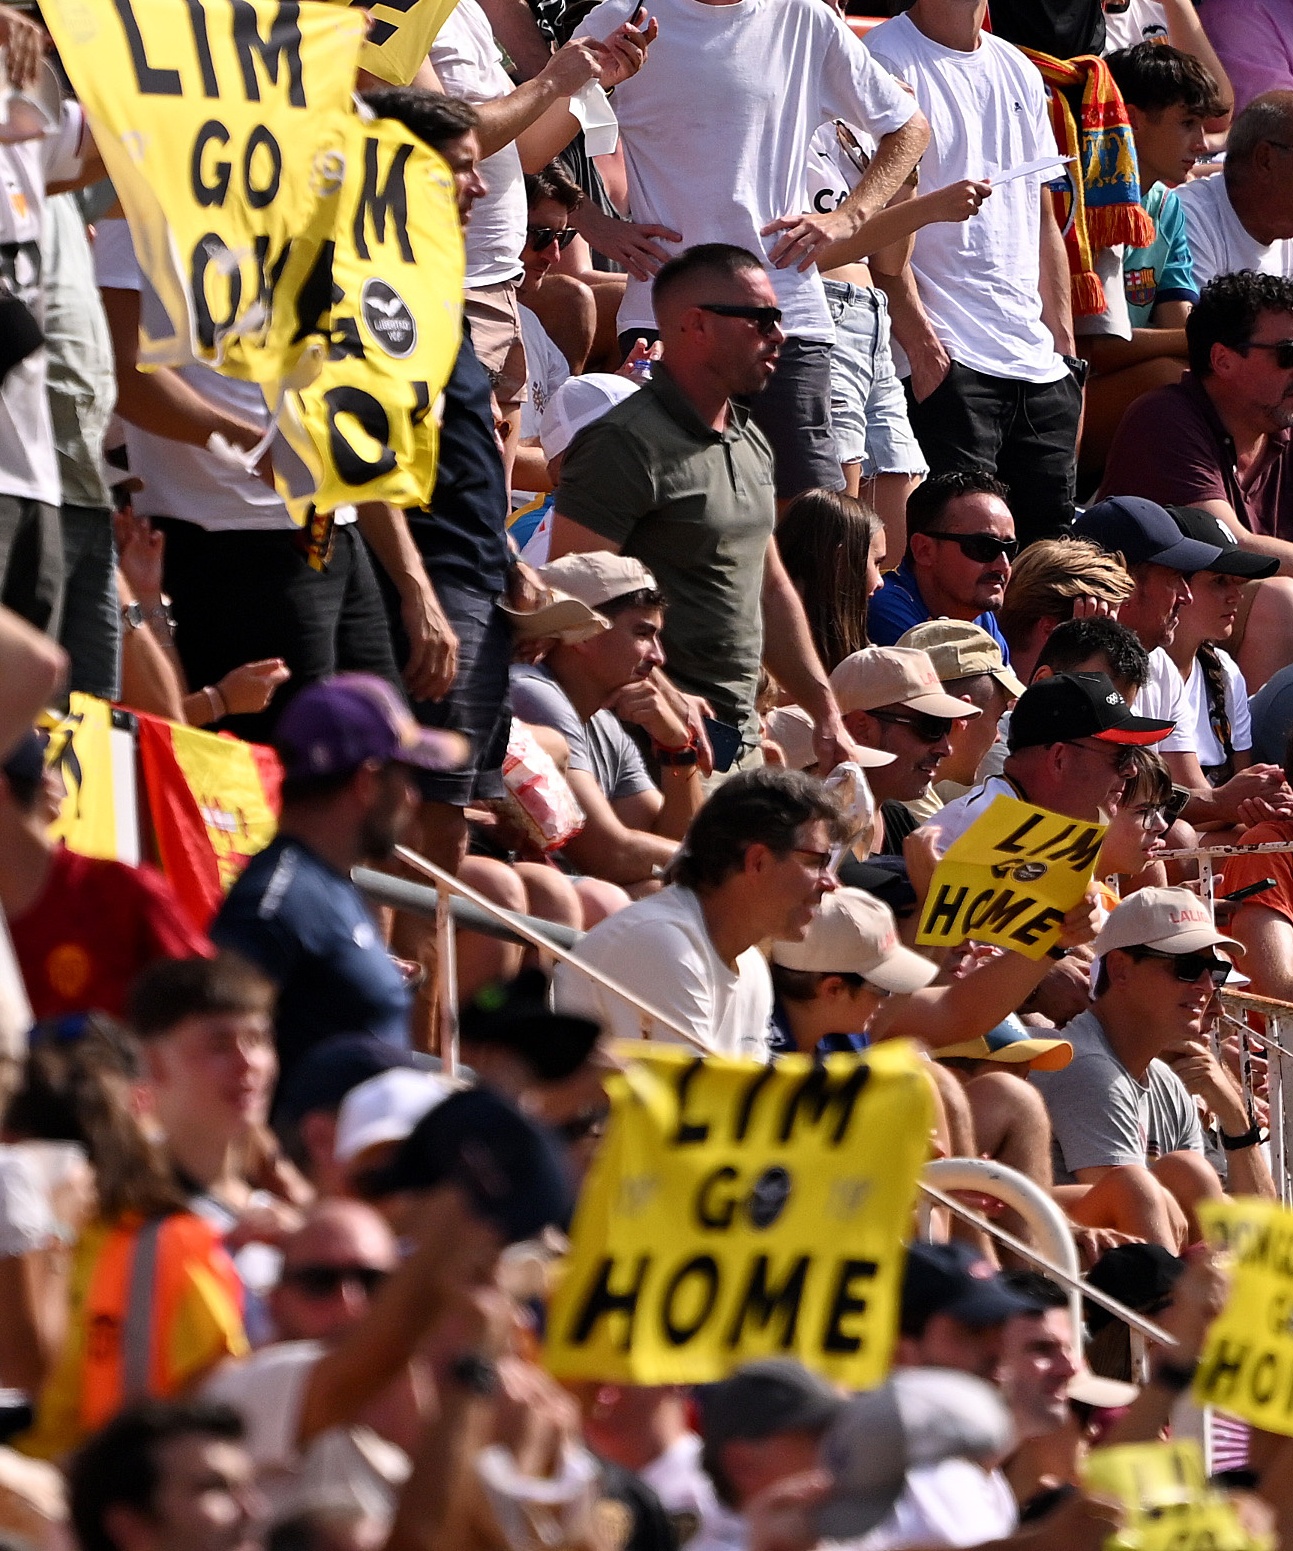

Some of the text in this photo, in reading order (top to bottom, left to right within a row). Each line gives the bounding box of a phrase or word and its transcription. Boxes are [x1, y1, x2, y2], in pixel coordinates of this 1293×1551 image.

[190, 118, 282, 209] GO
[995, 812, 1106, 872] LIM
[924, 883, 1065, 948] HOME
[670, 1058, 871, 1148] LIM
[695, 1166, 792, 1233] GO
[573, 1256, 878, 1355] HOME
